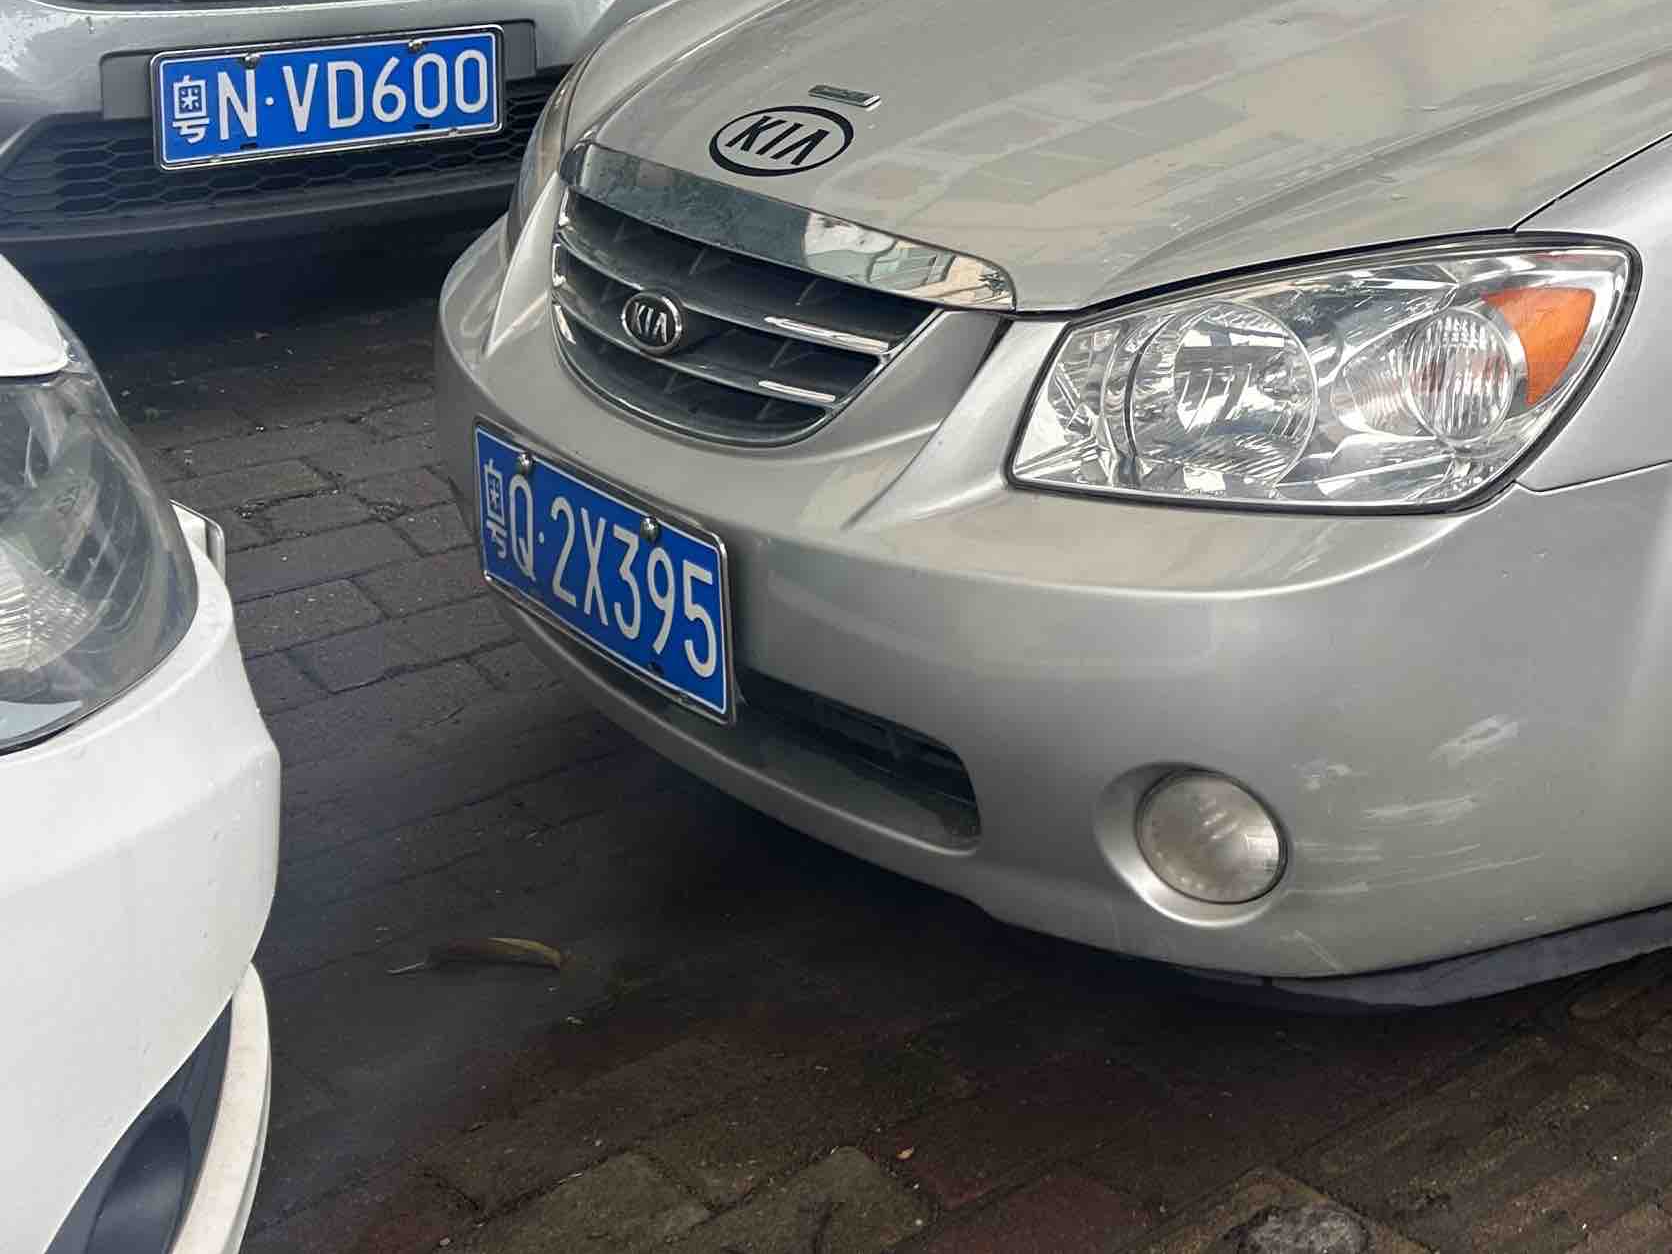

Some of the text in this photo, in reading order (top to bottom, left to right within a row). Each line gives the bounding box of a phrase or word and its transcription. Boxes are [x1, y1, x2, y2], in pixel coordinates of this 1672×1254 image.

[172, 49, 488, 143] 粤N·VD600
[724, 114, 830, 166] KIA
[632, 301, 668, 344] KIA
[483, 457, 717, 678] 粤Q·2X395
